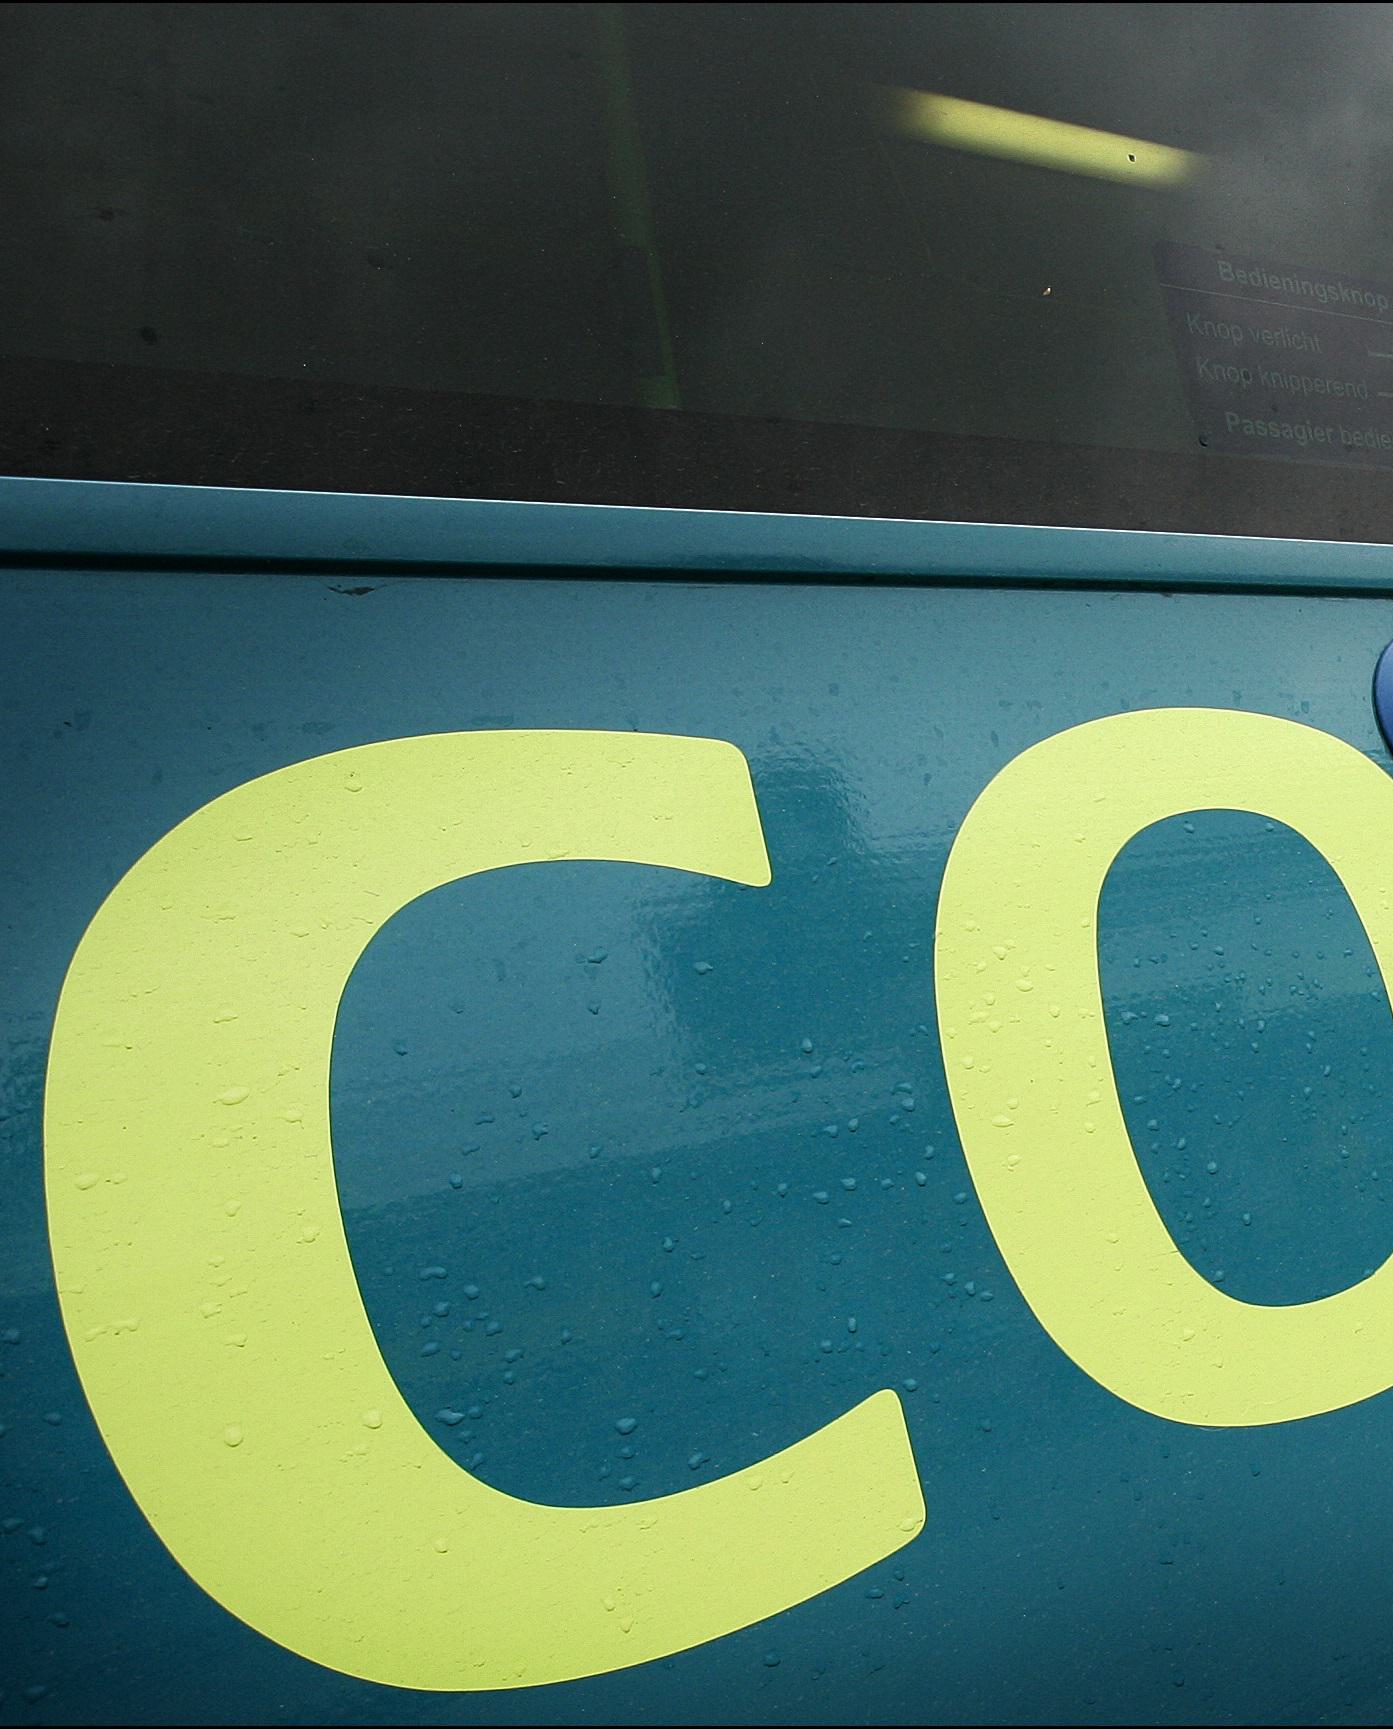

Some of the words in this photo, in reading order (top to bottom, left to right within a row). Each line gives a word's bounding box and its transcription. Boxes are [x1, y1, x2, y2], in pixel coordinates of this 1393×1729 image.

[1217, 261, 1389, 312] Bedieningsknop
[1186, 312, 1243, 345] Knop
[1250, 327, 1323, 354] verlicht
[1196, 357, 1253, 389] Knop
[1257, 365, 1369, 400] knipperend
[1225, 411, 1333, 446] Passagier
